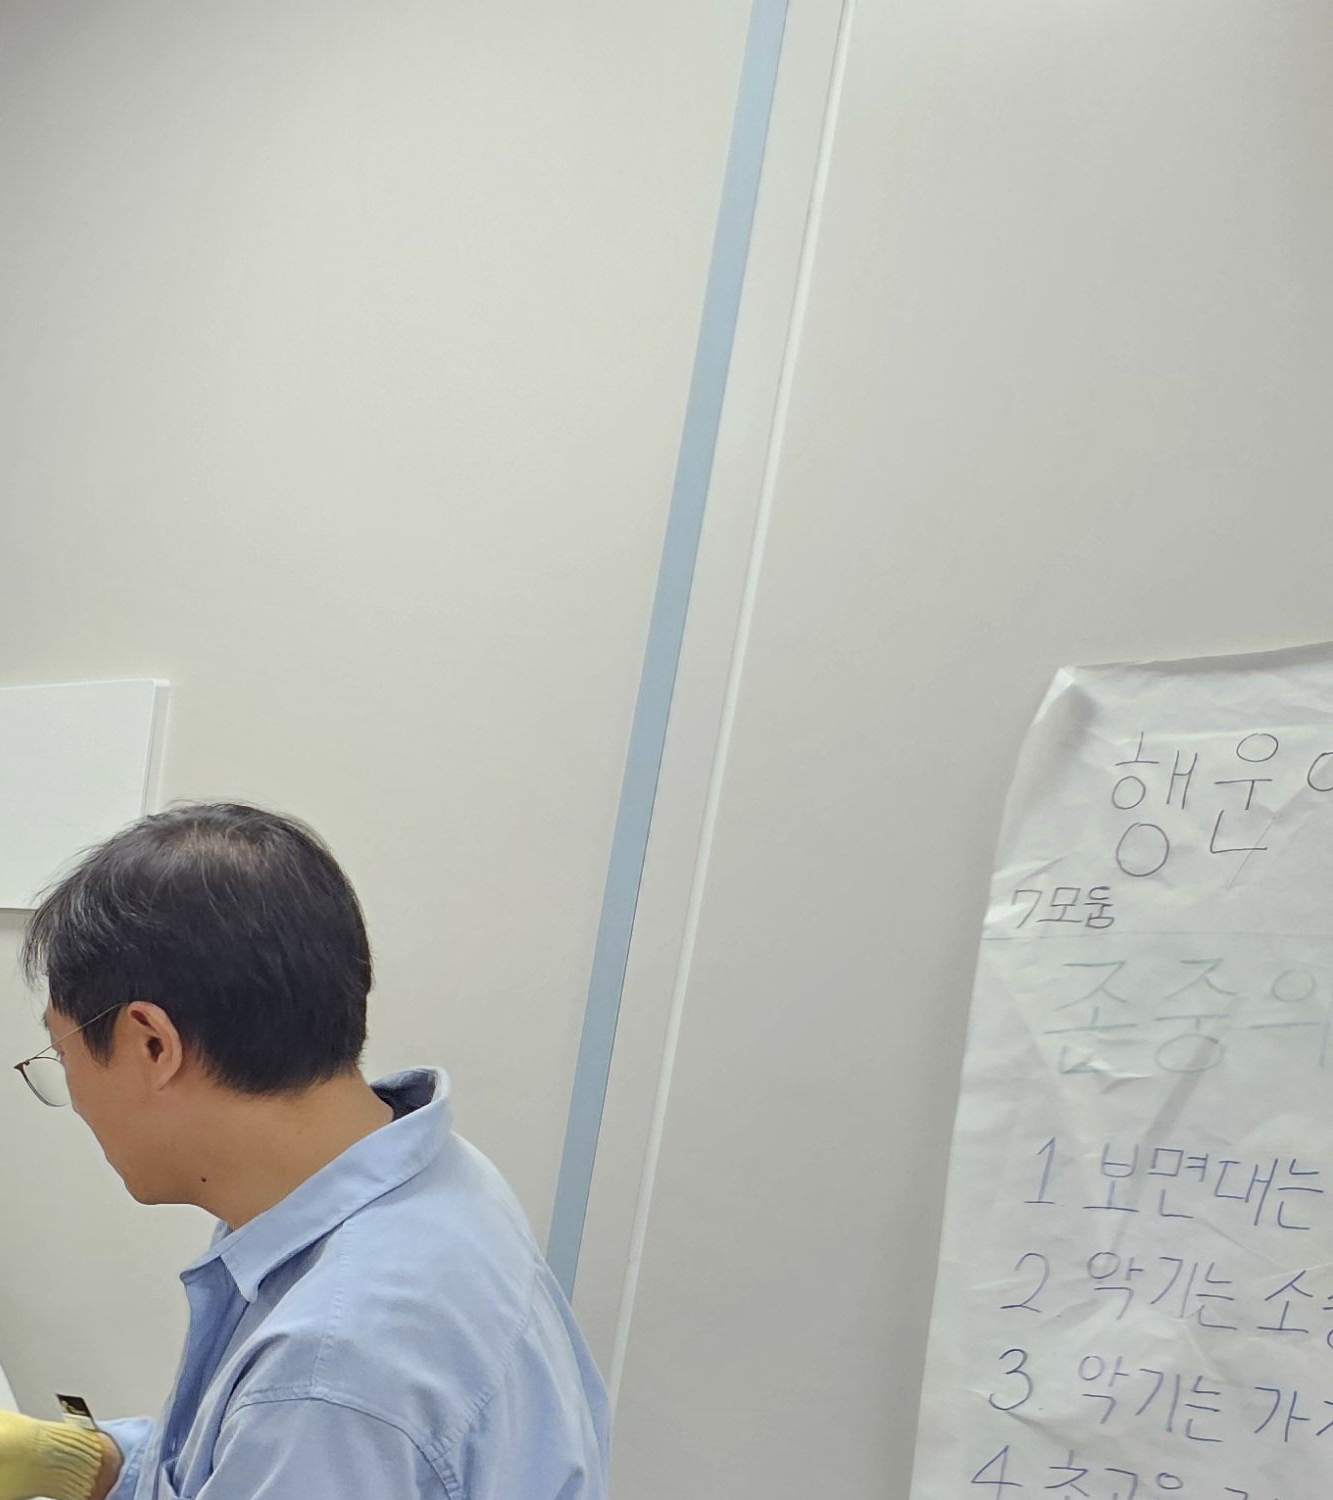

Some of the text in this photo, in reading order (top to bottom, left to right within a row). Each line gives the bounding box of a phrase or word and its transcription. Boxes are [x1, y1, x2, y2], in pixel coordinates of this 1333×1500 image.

[1083, 1143, 1324, 1230] 보면대는
[1086, 1251, 1238, 1330] 악기는
[1078, 1355, 1224, 1443] 악기는
